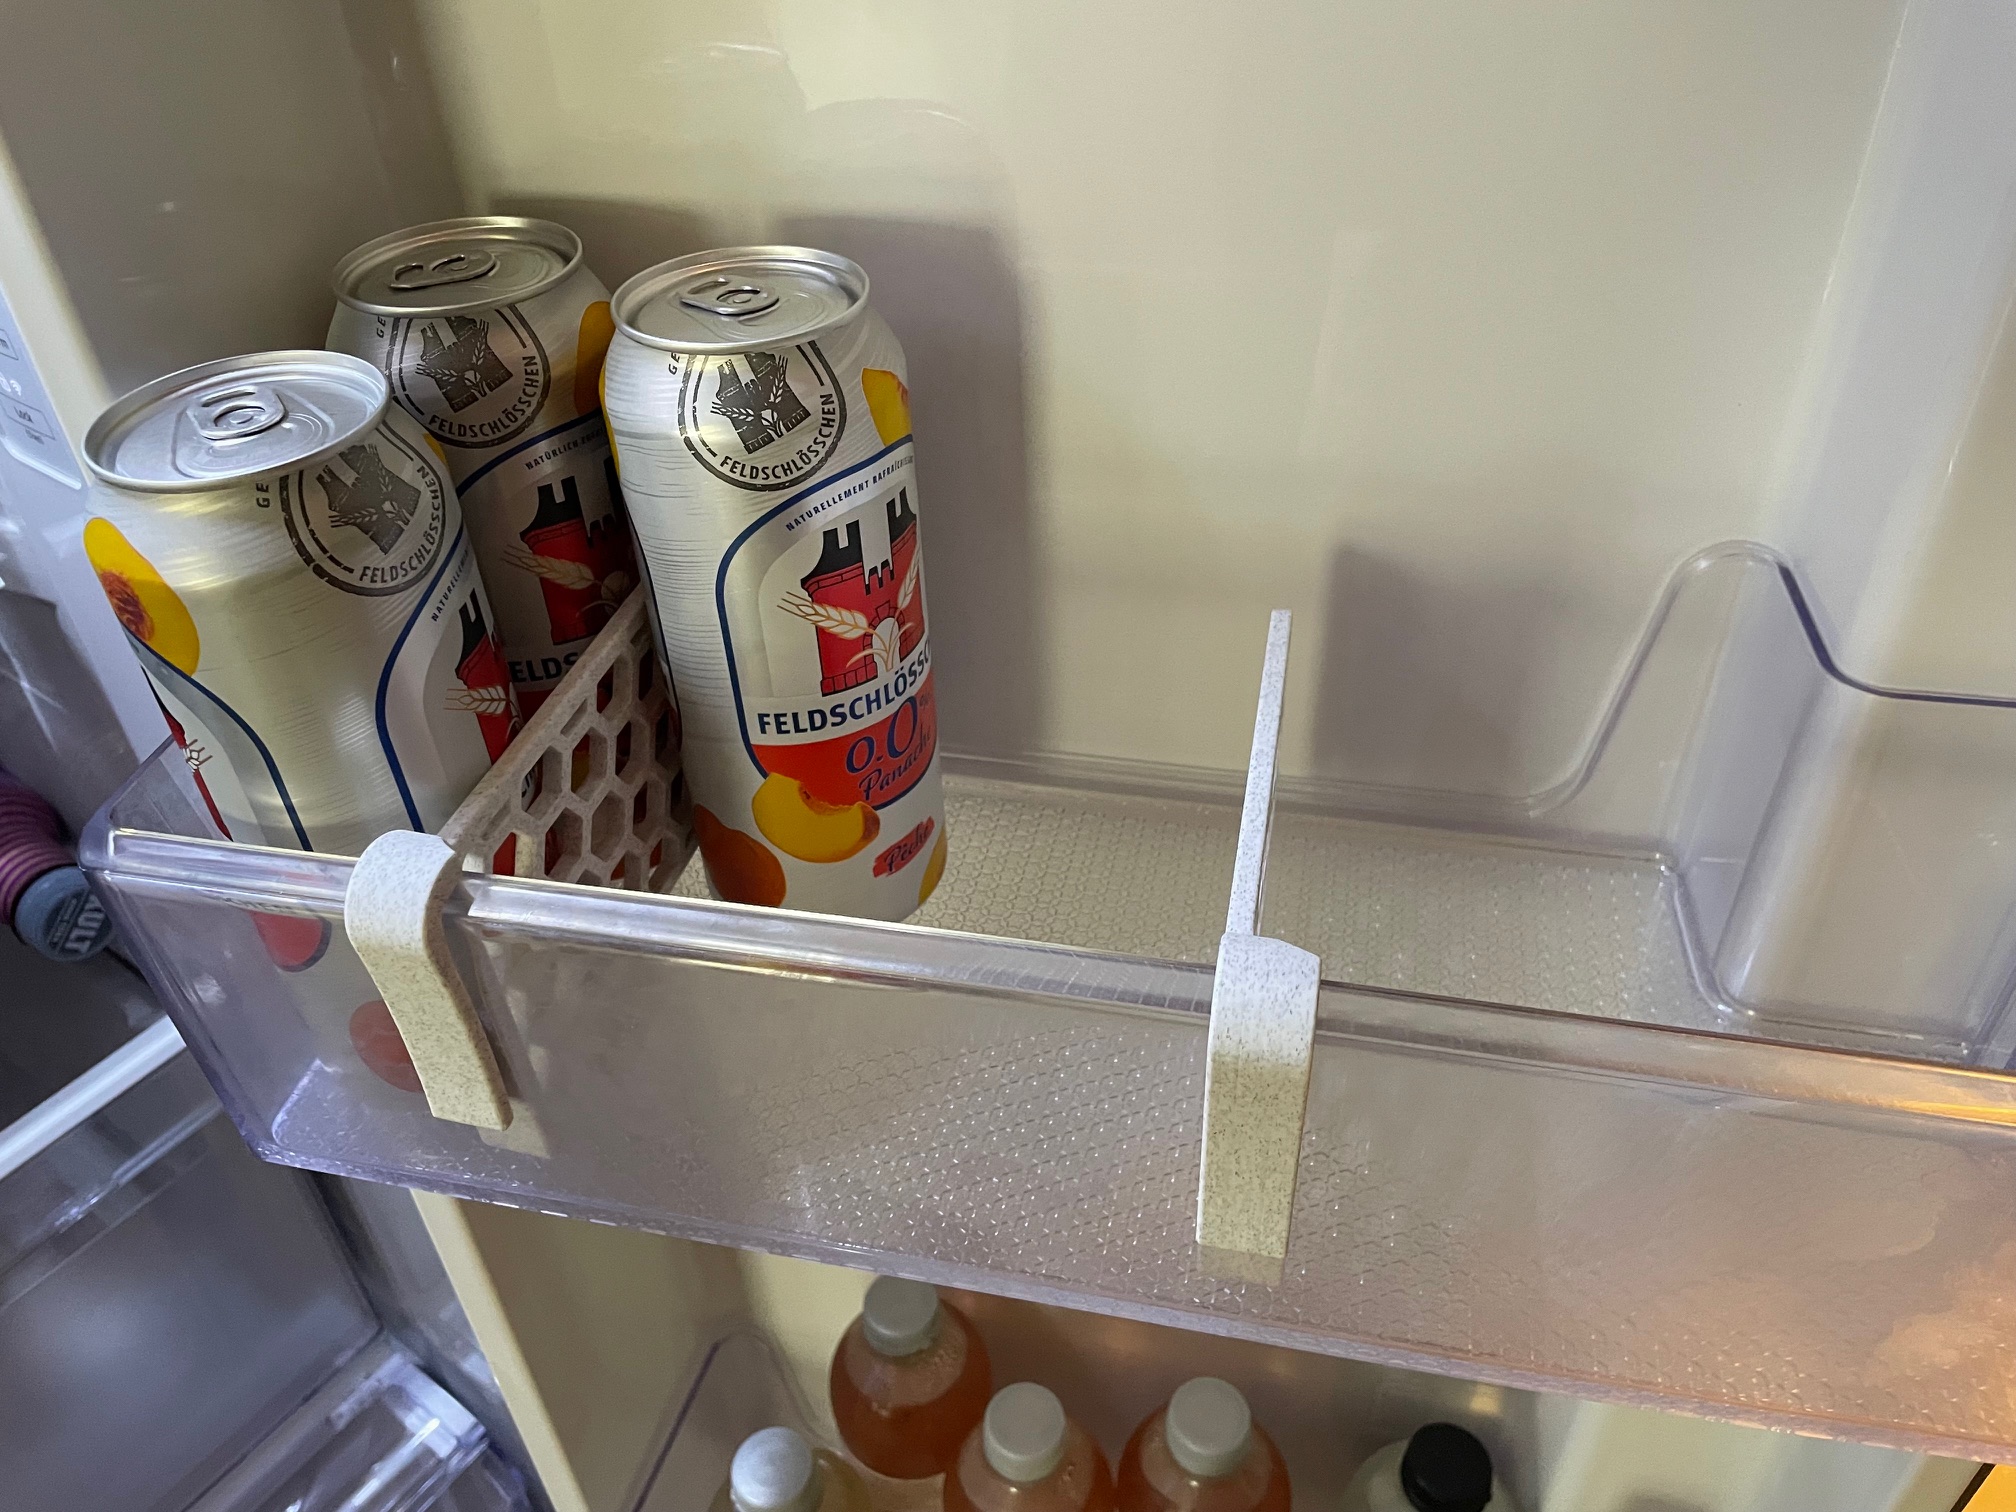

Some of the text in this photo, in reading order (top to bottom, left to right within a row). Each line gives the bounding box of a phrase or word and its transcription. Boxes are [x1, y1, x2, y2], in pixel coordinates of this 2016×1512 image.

[429, 355, 540, 438] FELDSCHLÖSSCHEN
[719, 393, 836, 480] FELDSCHLÖSSCHEN
[359, 465, 441, 584] FELDSCHLÖSSCHEN
[785, 479, 870, 532] NATURELLEMENT
